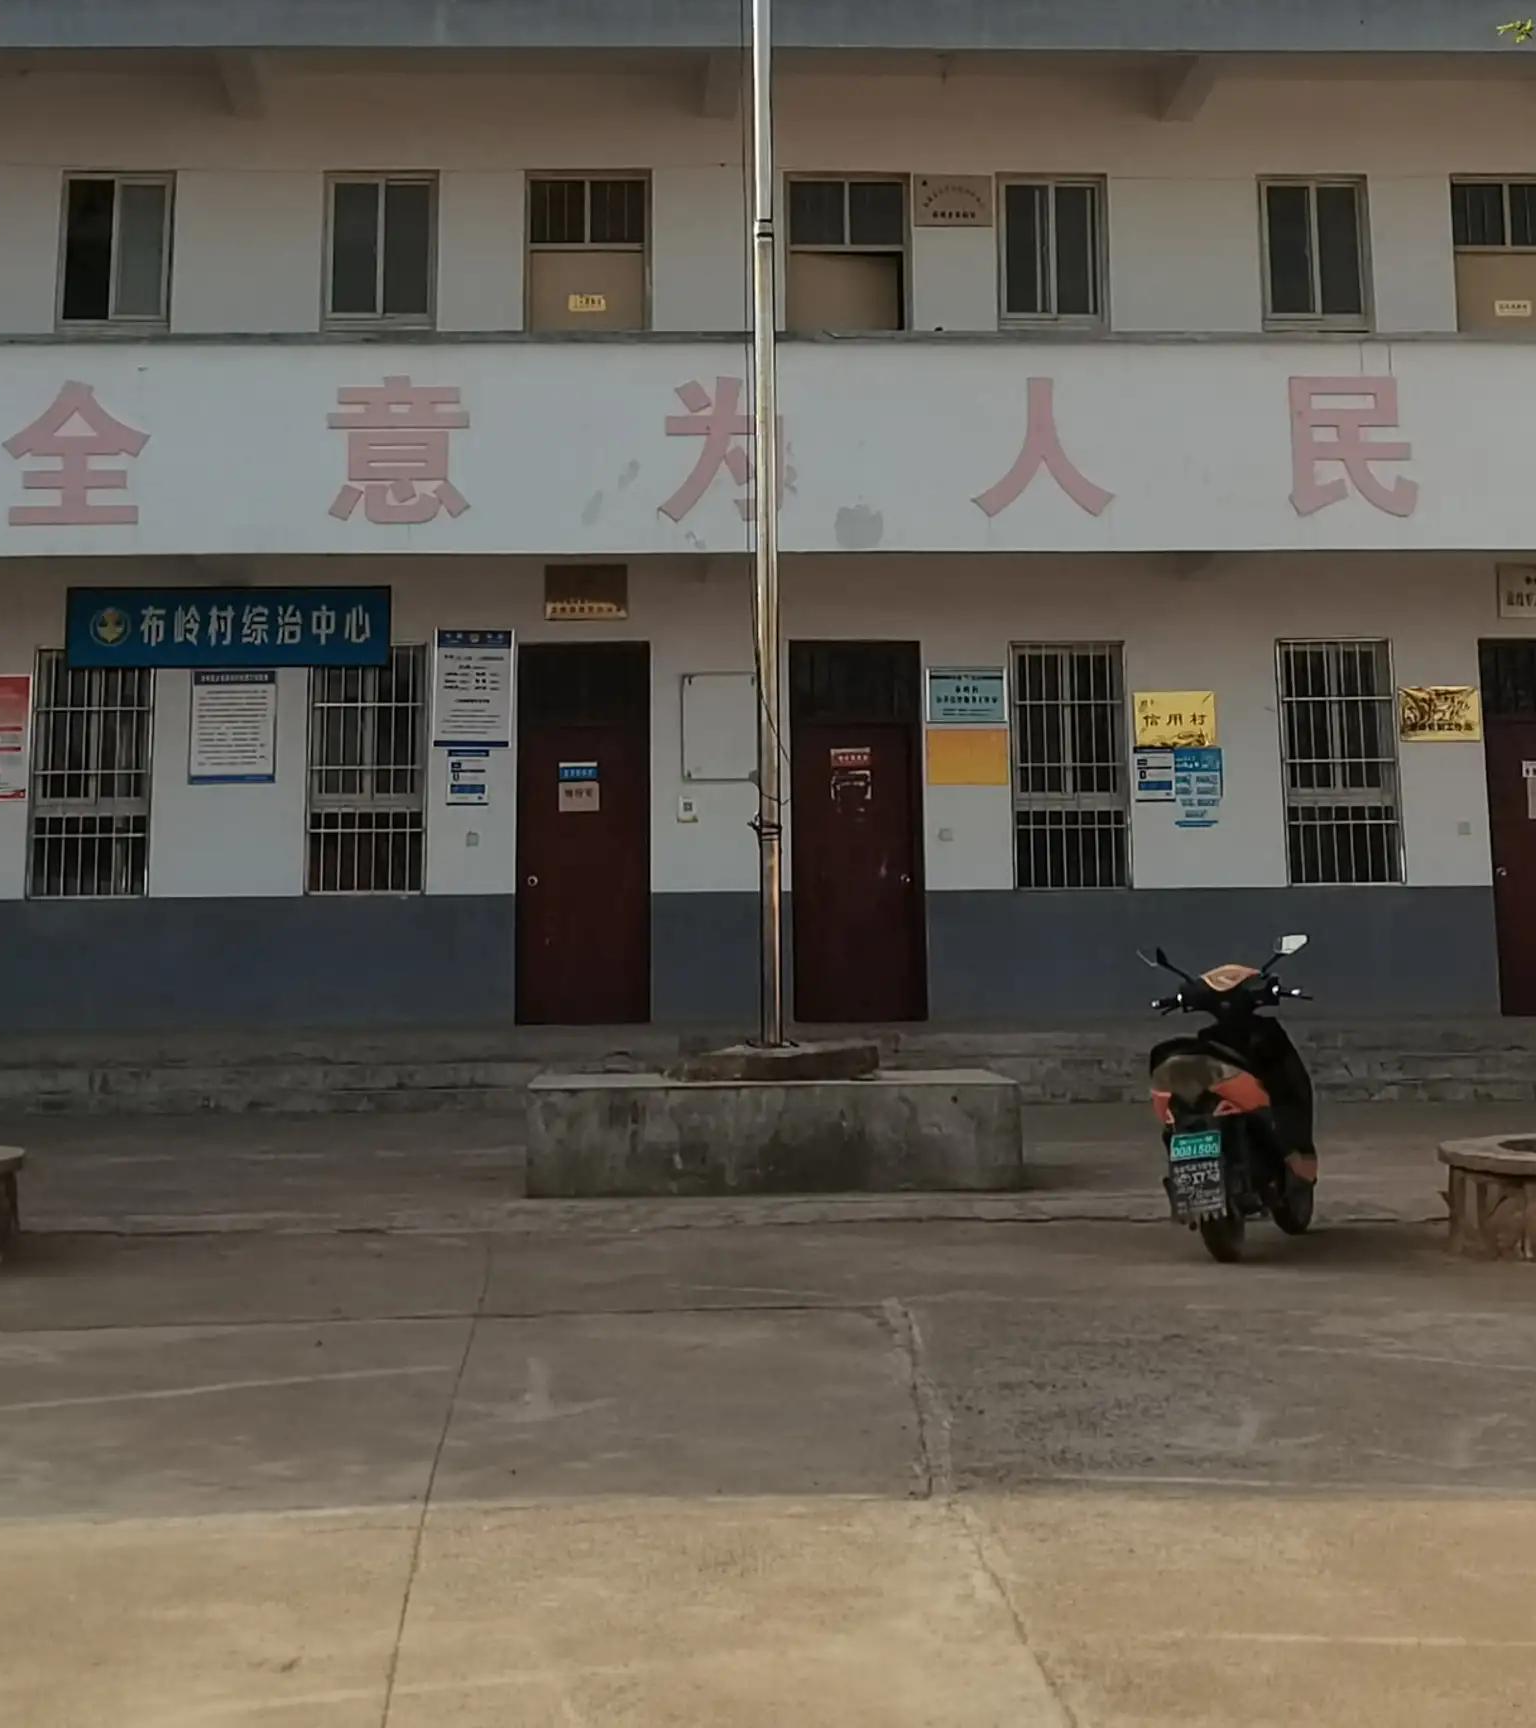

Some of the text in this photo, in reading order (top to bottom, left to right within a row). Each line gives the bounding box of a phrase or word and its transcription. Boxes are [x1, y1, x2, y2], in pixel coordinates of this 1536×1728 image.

[140, 605, 371, 647] 布岭村综治中心
[1142, 712, 1208, 727] 信用村
